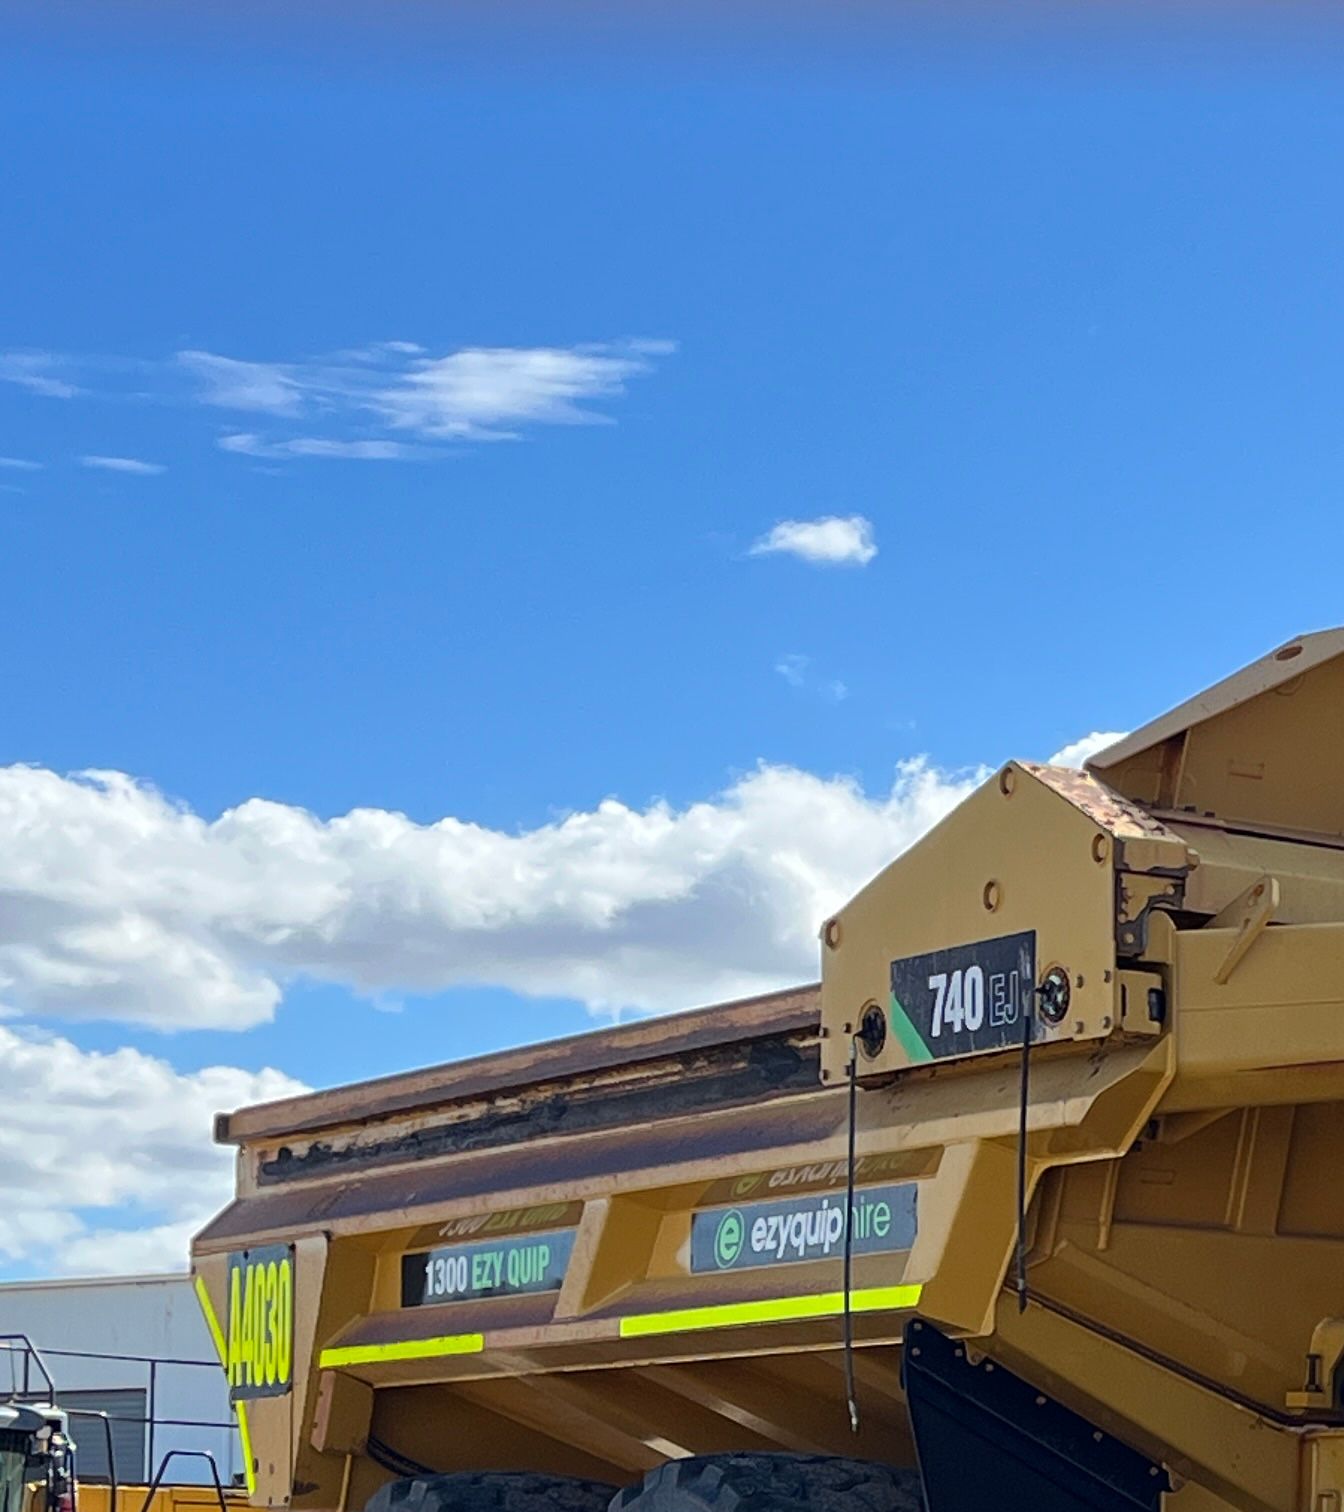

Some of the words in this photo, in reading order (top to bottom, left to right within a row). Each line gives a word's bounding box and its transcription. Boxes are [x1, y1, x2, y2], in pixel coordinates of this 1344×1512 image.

[928, 965, 985, 1038] 740
[989, 970, 1019, 1027] EJ
[425, 1255, 468, 1297] 1300
[472, 1251, 505, 1290] EZY
[507, 1245, 550, 1288] QUIP
[228, 1258, 292, 1388] A4030
